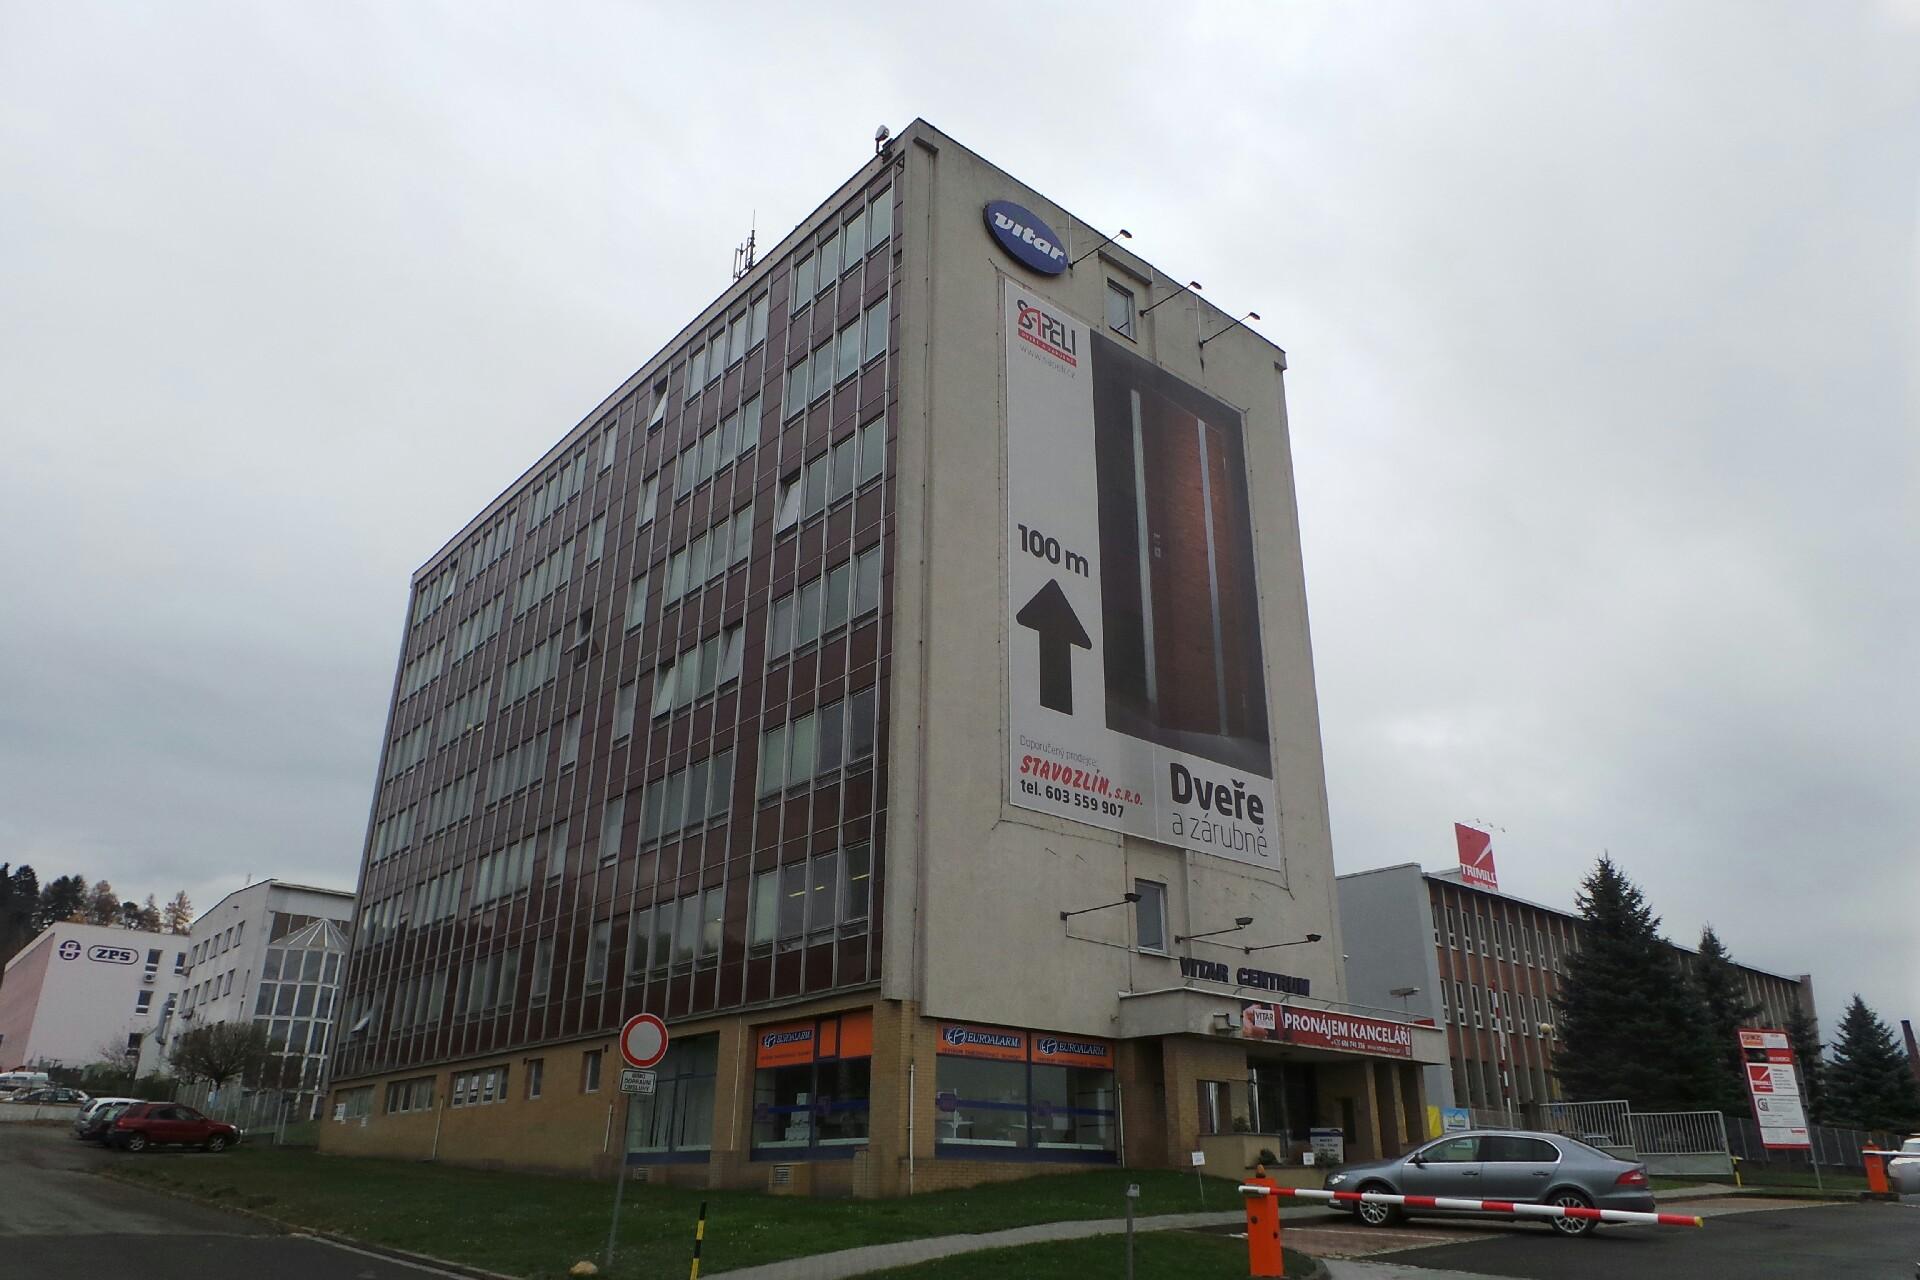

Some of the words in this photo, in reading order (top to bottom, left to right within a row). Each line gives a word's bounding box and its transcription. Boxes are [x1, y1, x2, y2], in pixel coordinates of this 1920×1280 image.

[995, 212, 1065, 260] vitar
[1018, 523, 1061, 565] 100
[1065, 550, 1089, 578] m
[1020, 779, 1042, 797] tel.
[1045, 785, 1070, 804] 603
[1074, 793, 1098, 811] 559
[1102, 801, 1124, 818] 907
[1170, 763, 1264, 826] Dveře
[1172, 812, 1183, 836] a
[1189, 813, 1268, 857] zárubně
[1460, 863, 1497, 884] TRIMILL
[96, 949, 131, 961] ZPS
[1179, 957, 1229, 983] VITAR
[1237, 967, 1310, 997] CENTRUM
[1255, 1011, 1274, 1022] VITAR
[1284, 1012, 1348, 1040] PRONÁJEM
[1350, 1023, 1410, 1046] KANCELÁŘÍ
[968, 1032, 1018, 1048] EUROALARM
[1059, 1042, 1104, 1056] EUROALARM
